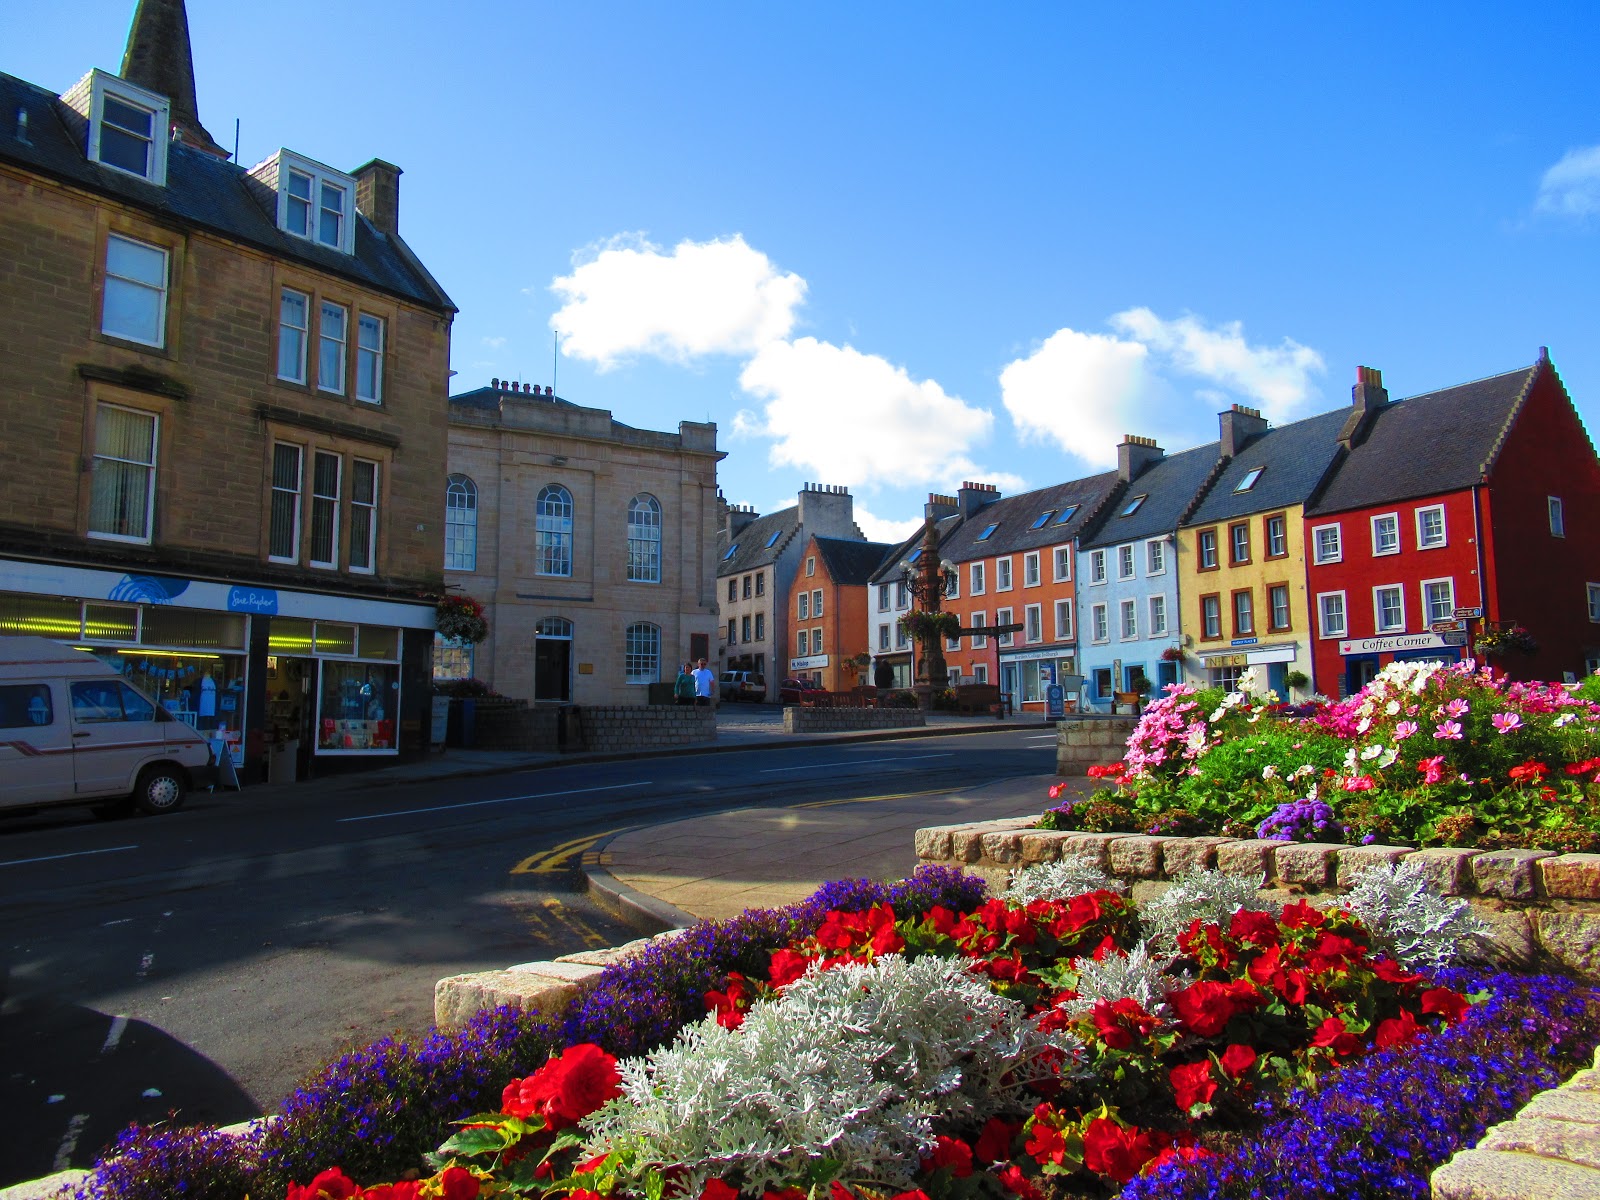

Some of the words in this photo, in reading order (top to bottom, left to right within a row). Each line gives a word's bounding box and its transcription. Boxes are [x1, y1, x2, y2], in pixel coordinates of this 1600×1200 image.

[232, 590, 249, 607] Sue
[249, 593, 275, 610] Ryder
[1362, 638, 1394, 652] Coffee
[1396, 636, 1432, 647] Corner
